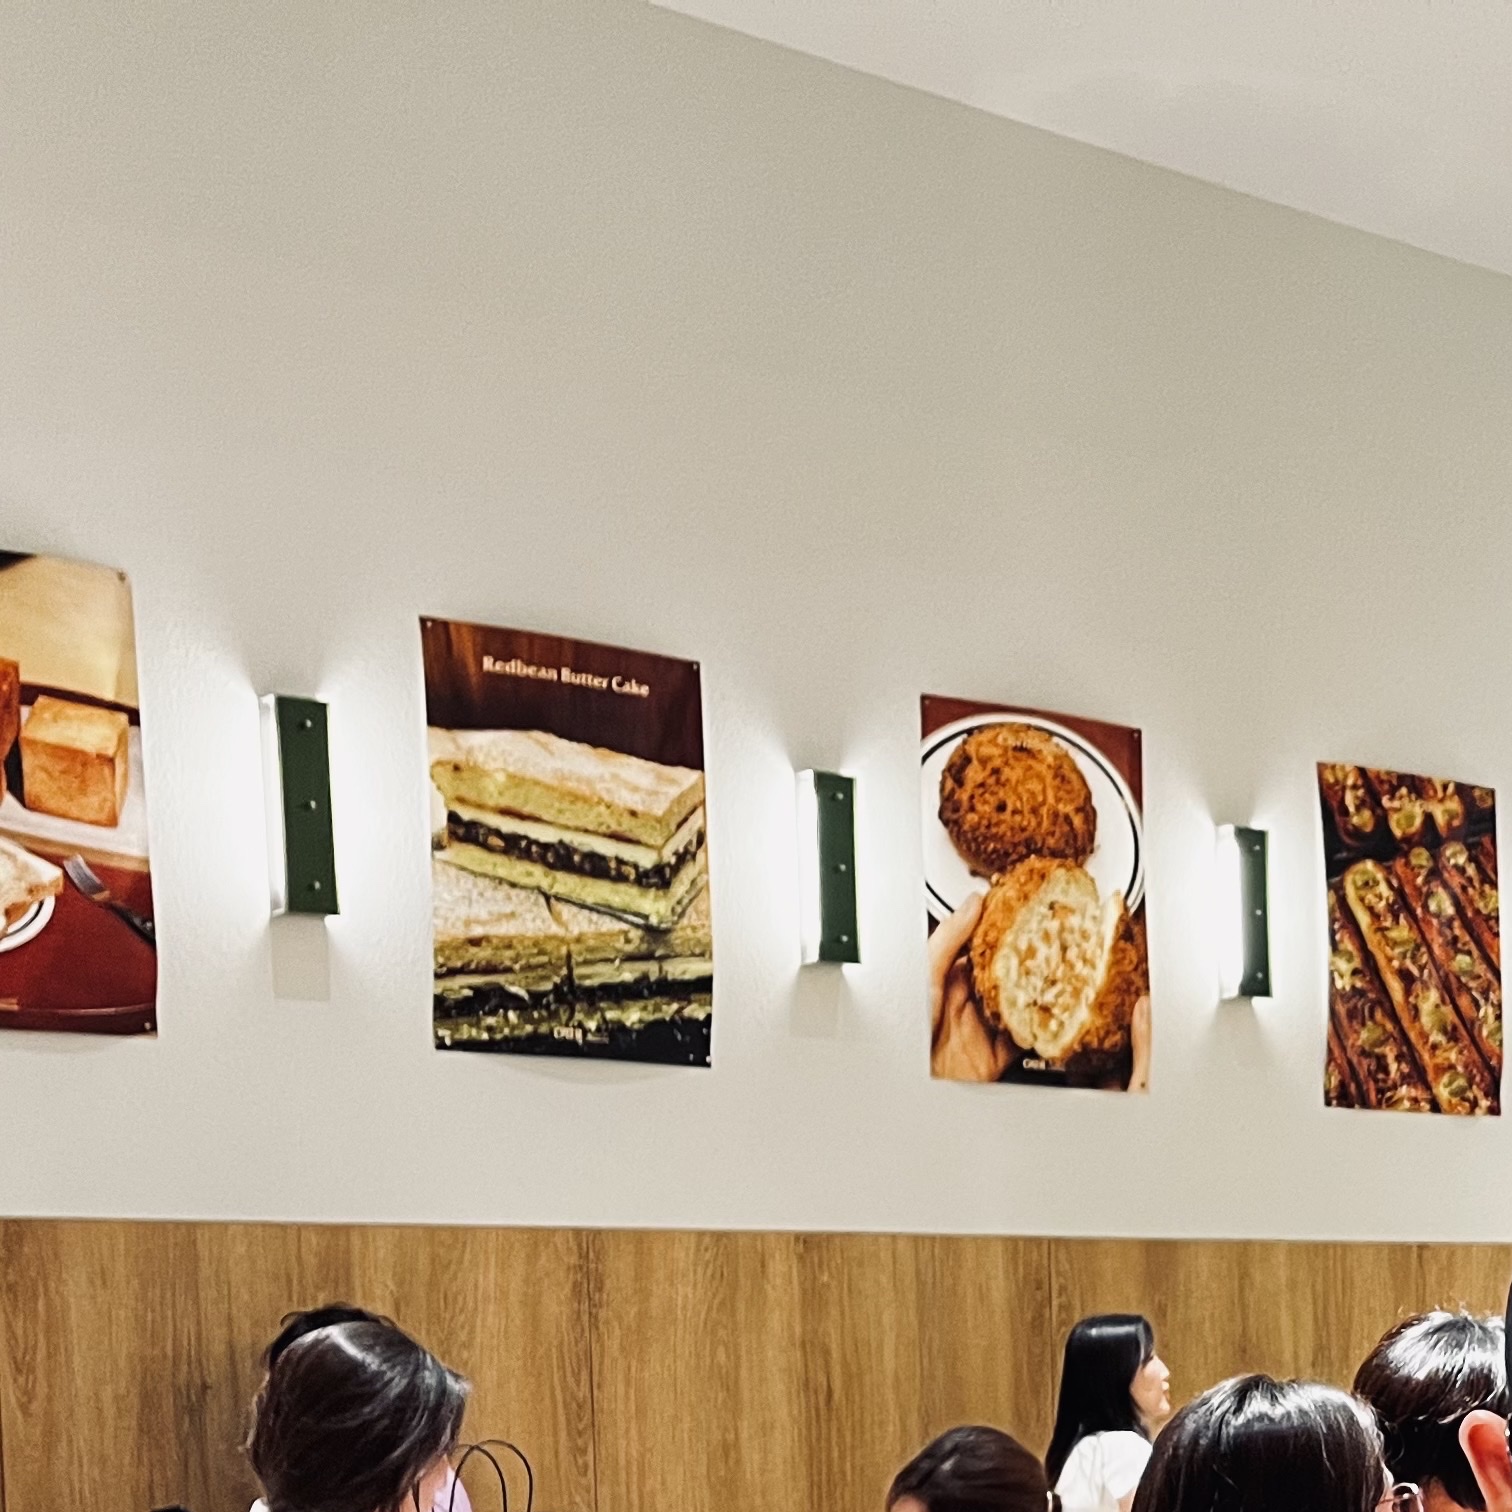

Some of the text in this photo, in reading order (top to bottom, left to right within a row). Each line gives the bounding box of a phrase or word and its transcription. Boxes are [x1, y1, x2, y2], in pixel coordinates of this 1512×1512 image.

[482, 655, 650, 698] Redbean Butter Cake
